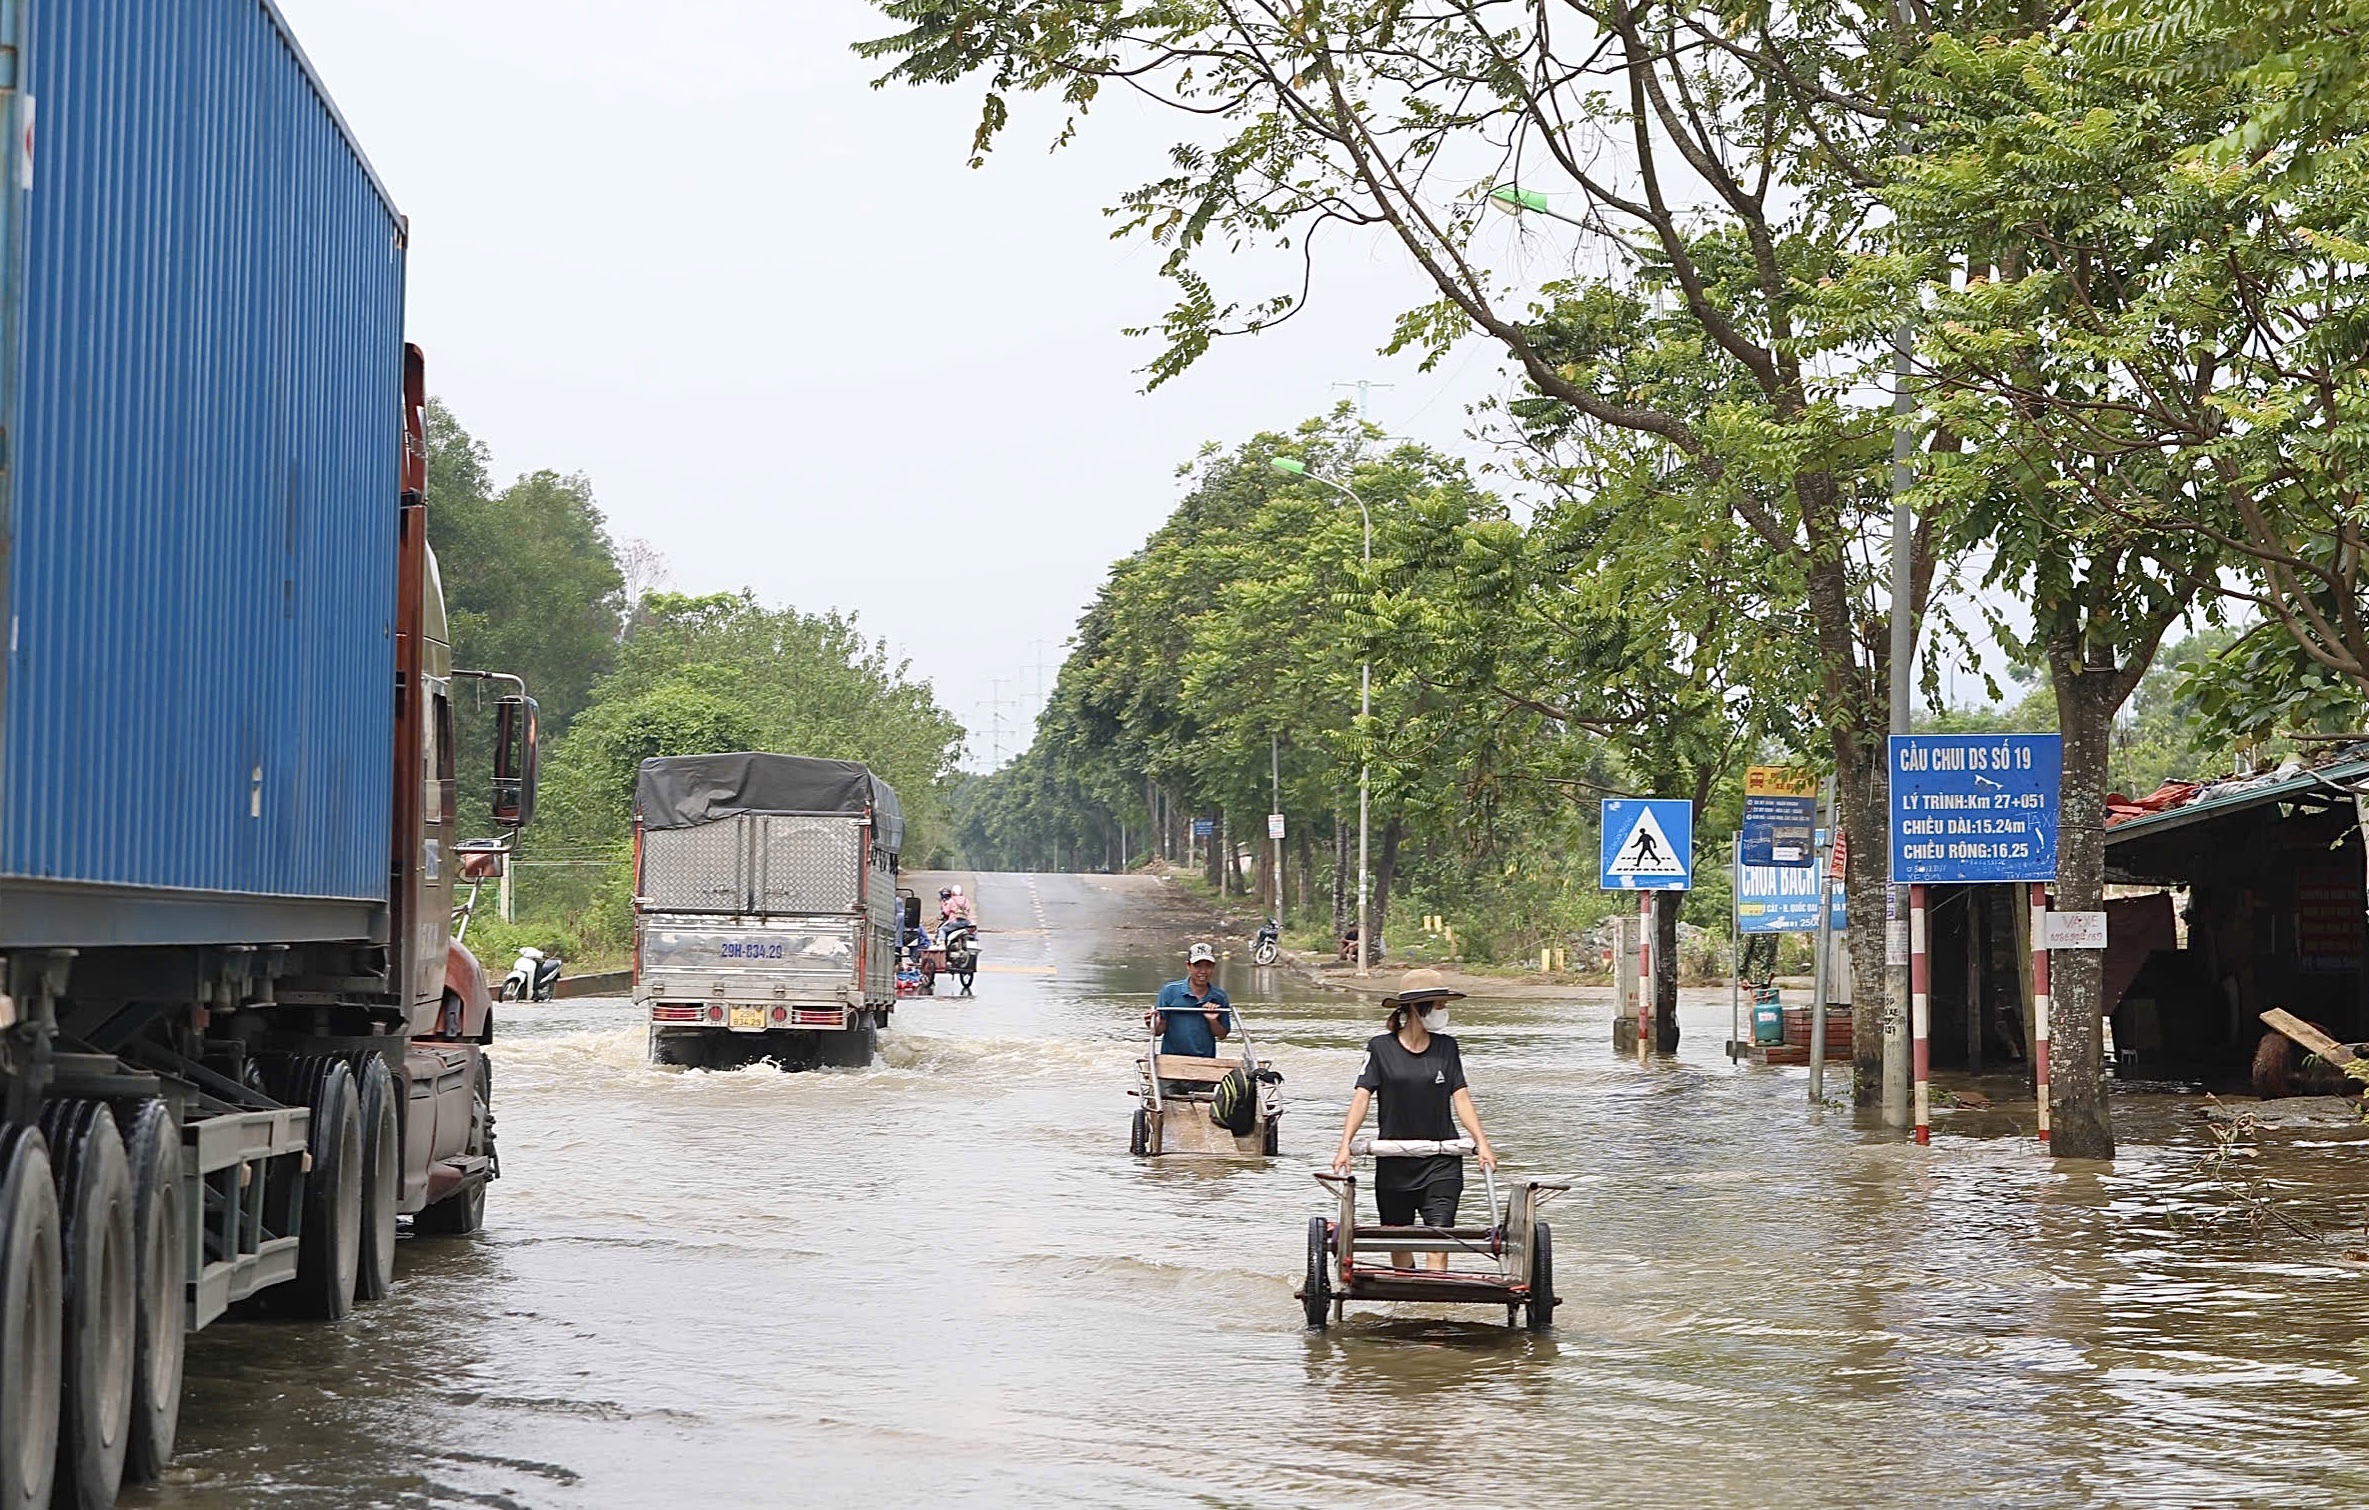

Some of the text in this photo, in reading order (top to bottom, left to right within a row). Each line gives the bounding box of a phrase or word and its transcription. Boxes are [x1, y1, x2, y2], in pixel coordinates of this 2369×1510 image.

[1901, 739, 2031, 771] CẦU CHUI DS SỐ 19
[1903, 792, 1919, 810] LÝ
[1994, 794, 2045, 810] 27+051
[1903, 815, 1944, 835] CHIỀU
[1904, 839, 1945, 859] CHIỀU
[721, 943, 783, 959] 29H-834.29
